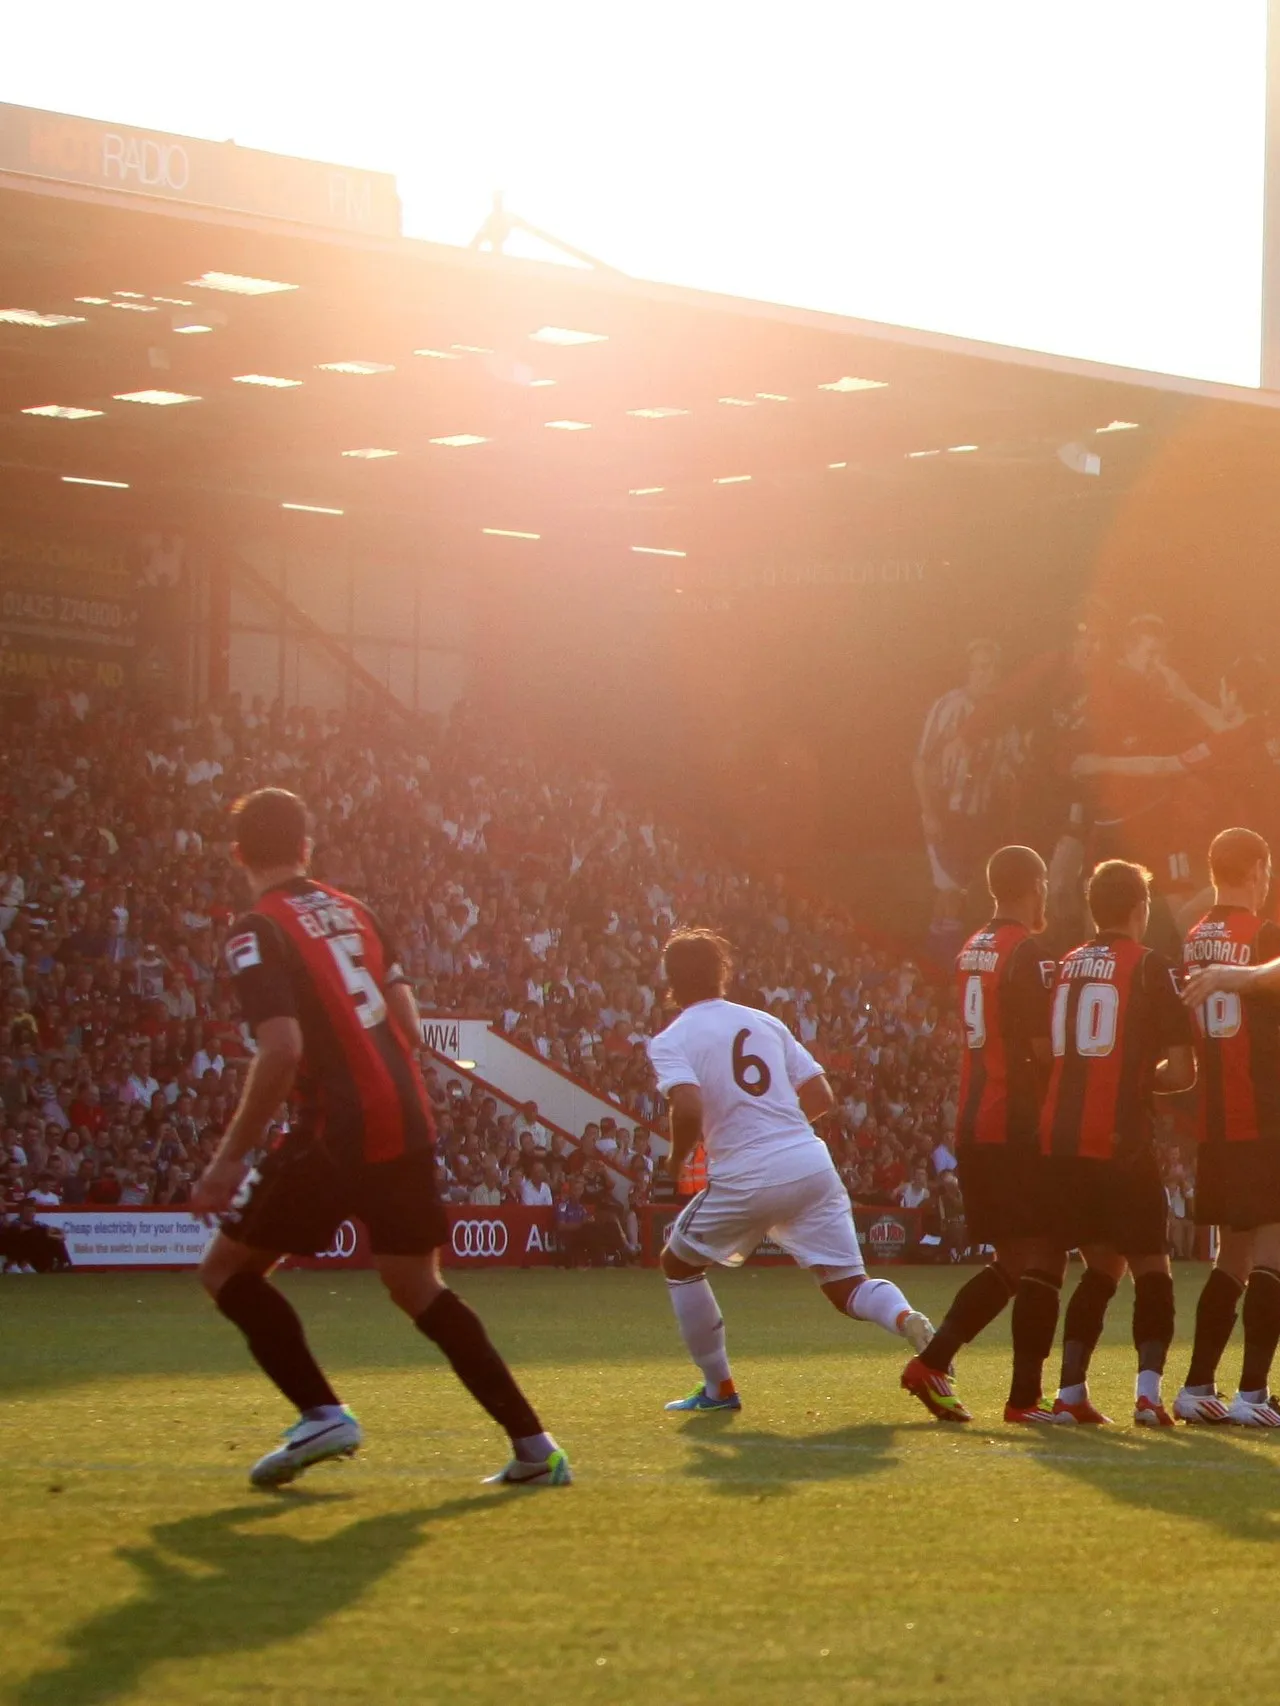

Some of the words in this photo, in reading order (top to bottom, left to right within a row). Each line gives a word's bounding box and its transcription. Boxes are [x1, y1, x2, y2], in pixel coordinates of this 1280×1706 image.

[103, 132, 189, 190] RADIO
[329, 172, 373, 221] FM
[326, 933, 388, 1029] 5
[1059, 957, 1117, 980] PITMAN
[423, 1024, 458, 1053] WV4
[963, 975, 987, 1049] 9
[1051, 982, 1119, 1058] 10
[732, 1027, 771, 1097] 6
[63, 1221, 92, 1236] Cheap
[94, 1220, 137, 1235] electricity
[139, 1220, 152, 1234] for
[153, 1224, 174, 1237] your
[175, 1221, 201, 1234] home
